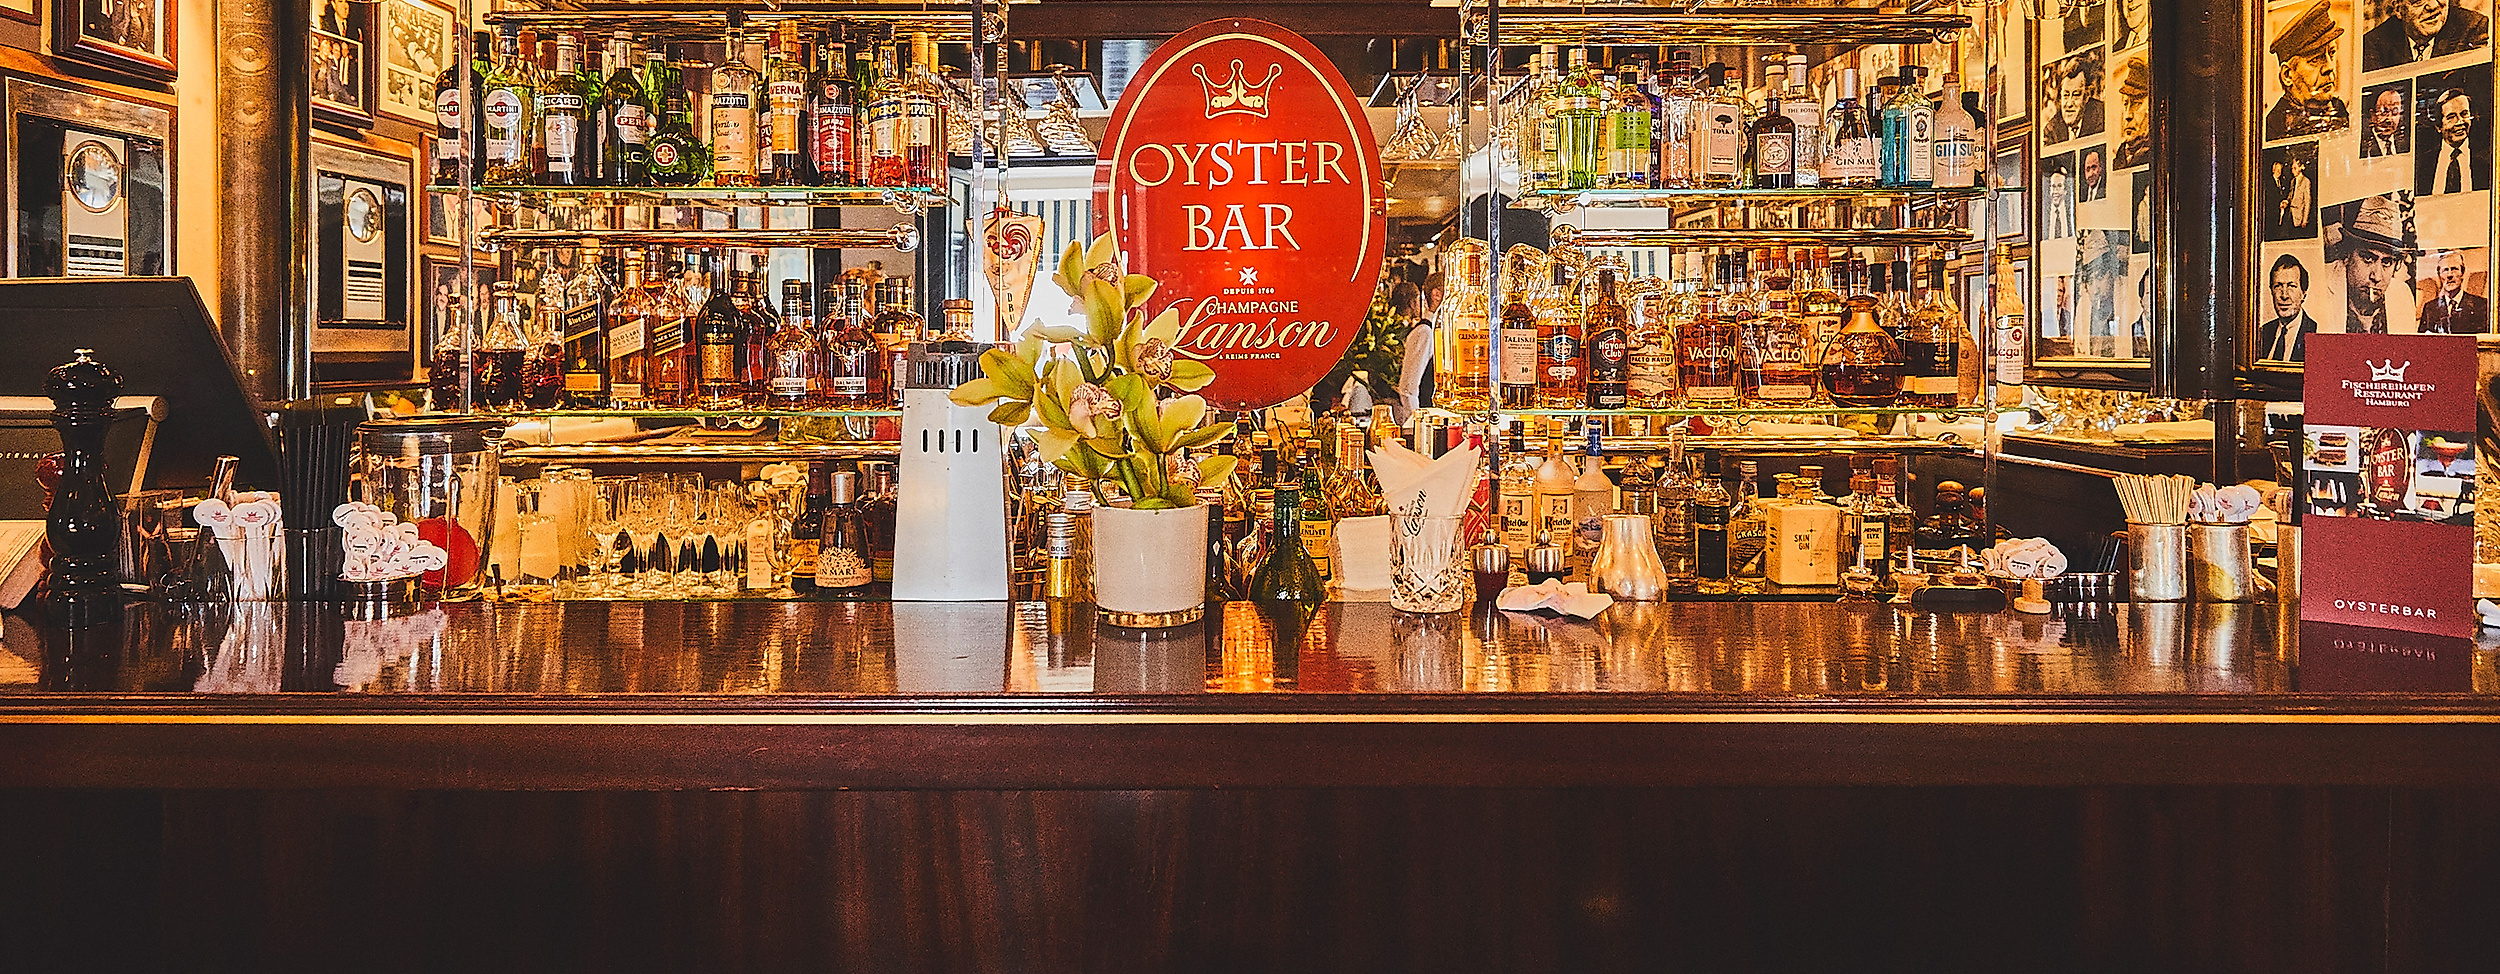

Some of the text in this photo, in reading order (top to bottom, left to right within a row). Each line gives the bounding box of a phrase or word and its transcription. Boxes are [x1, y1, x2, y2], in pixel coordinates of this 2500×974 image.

[487, 105, 517, 113] MARTINI
[869, 103, 902, 118] APEROL
[1128, 140, 1351, 190] OYSTER
[1182, 203, 1301, 252] BAR
[1223, 287, 1255, 295] DEPUIS
[1206, 300, 1299, 316] CHAMPAGNE
[1163, 296, 1338, 360] Lanson
[1605, 349, 1622, 358] Club
[1757, 346, 1810, 364] VACILÓN
[2341, 379, 2436, 392] FISCHEREIHAFEN
[2354, 388, 2423, 400] RESTAURANT
[2365, 398, 2410, 407] HAMBURG
[2372, 447, 2405, 464] OYSTER
[2377, 464, 2395, 478] BAR
[1794, 533, 1810, 542] SKIN
[830, 568, 858, 576] MARE
[2334, 599, 2437, 619] OYSTERBAR
